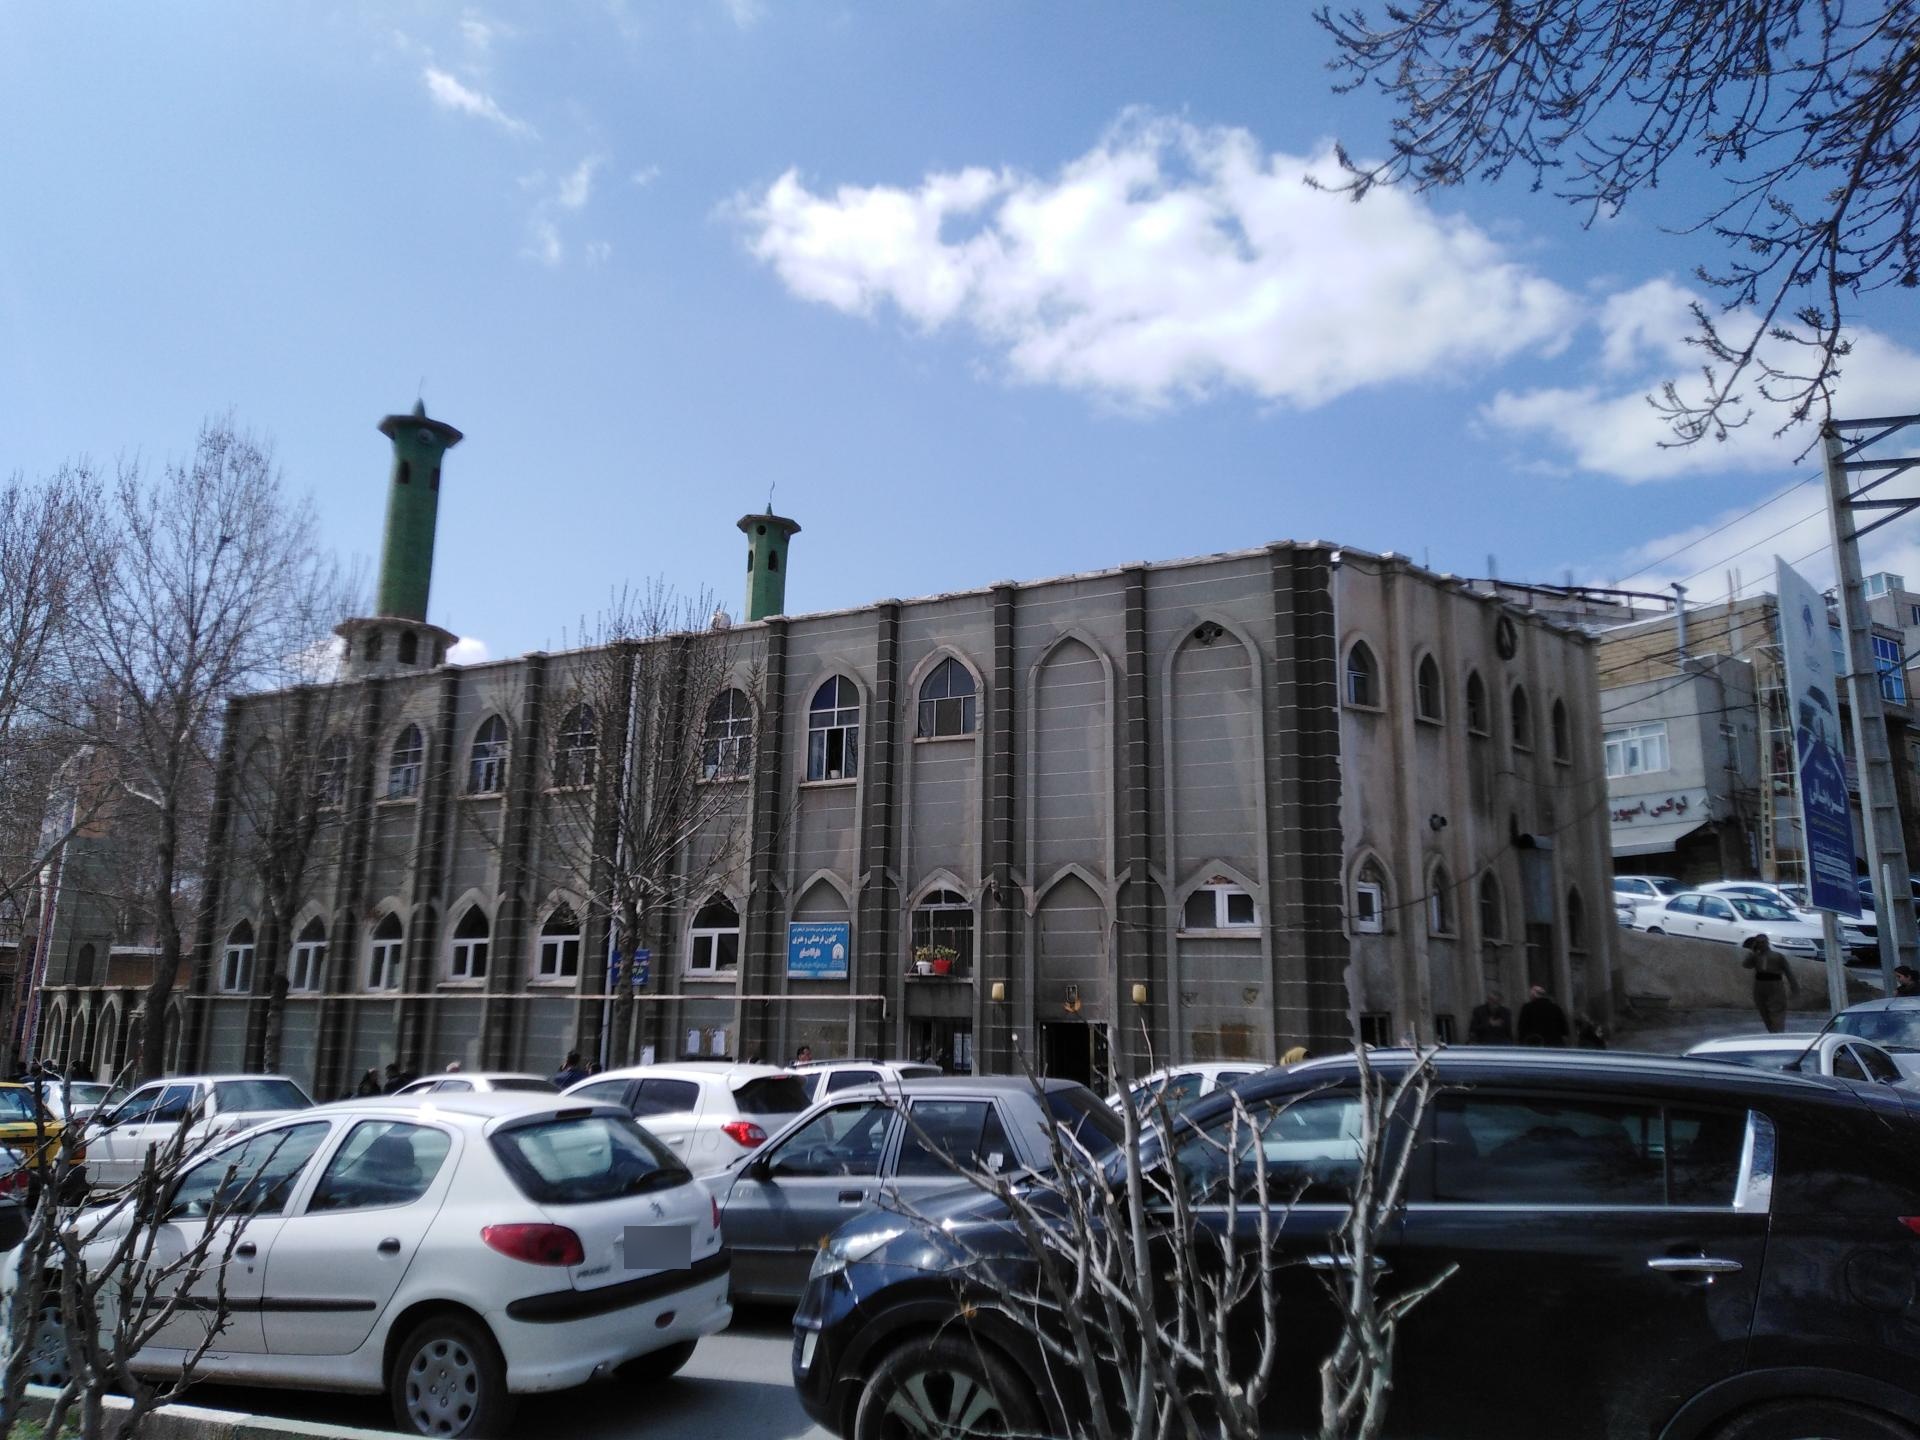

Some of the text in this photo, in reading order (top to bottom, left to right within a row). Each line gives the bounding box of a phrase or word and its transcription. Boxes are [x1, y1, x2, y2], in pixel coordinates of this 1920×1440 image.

[1650, 795, 1688, 818] لوکس
[792, 936, 804, 944] هنری
[807, 934, 824, 944] فرهنگی
[824, 934, 837, 944] کانون
